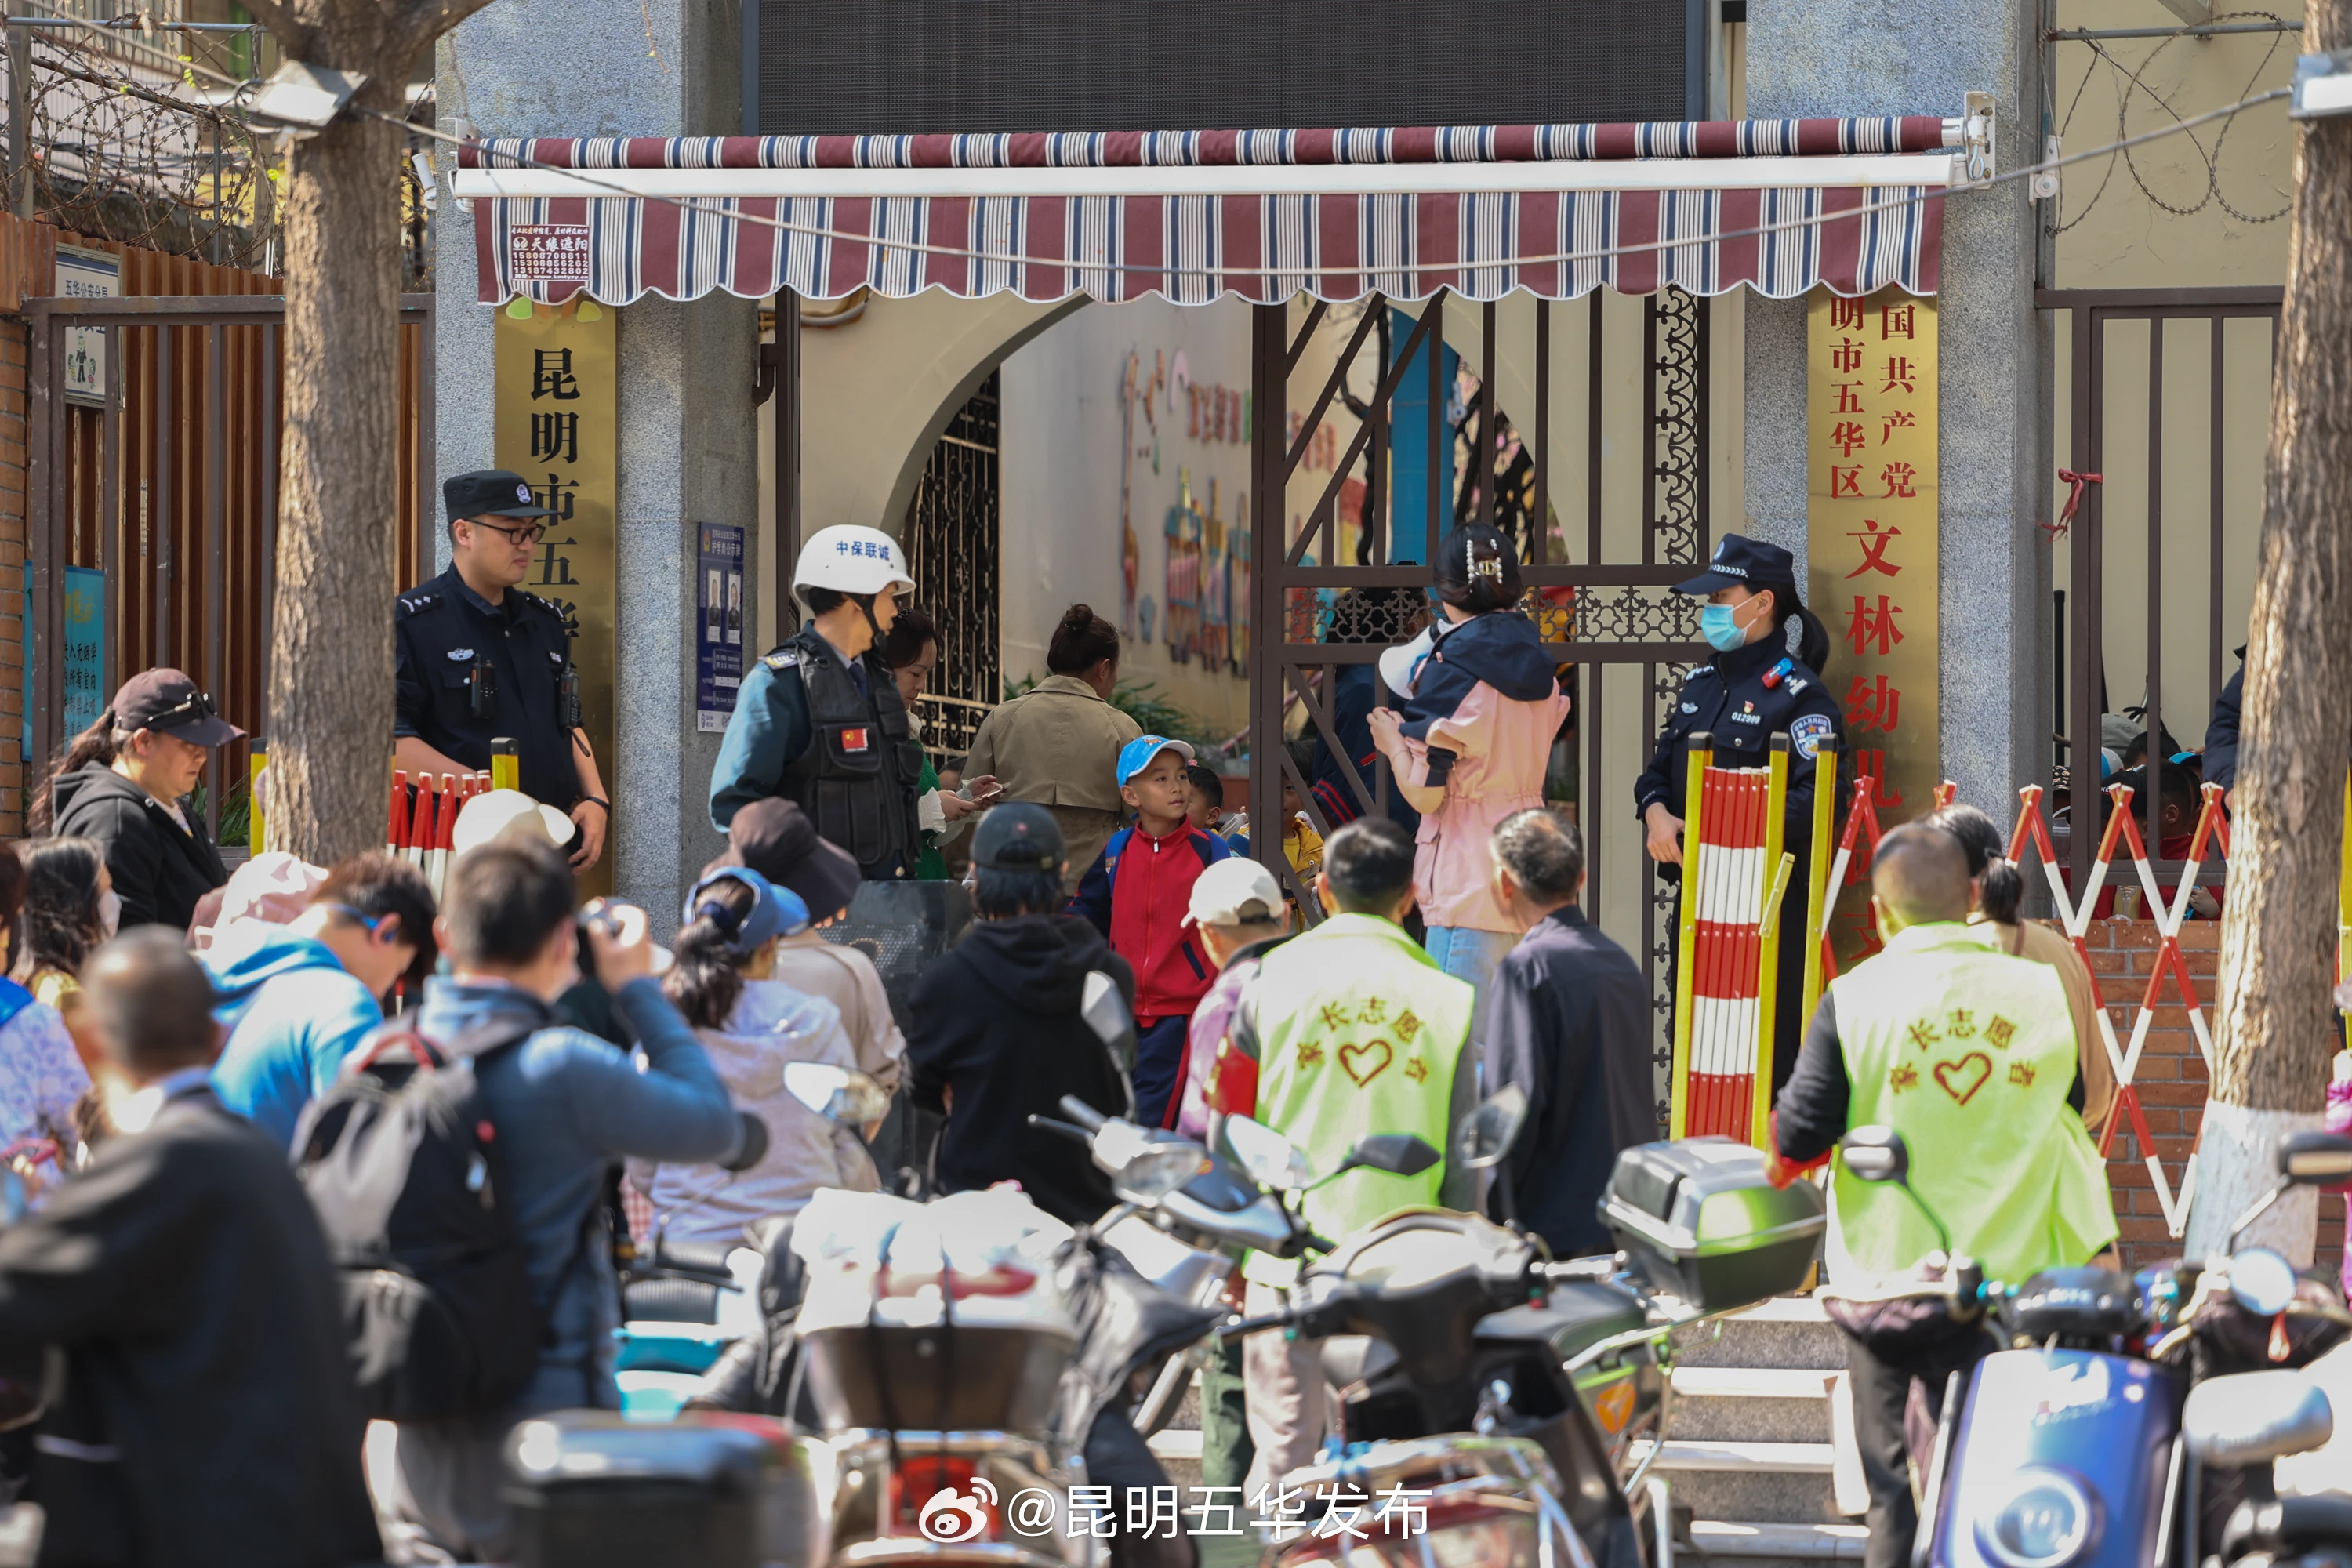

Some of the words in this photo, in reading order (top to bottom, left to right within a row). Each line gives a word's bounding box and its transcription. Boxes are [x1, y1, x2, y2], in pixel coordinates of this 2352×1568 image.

[531, 236, 589, 252] 天缘遮阳
[65, 279, 108, 298] 五华公安分局
[1878, 281, 1917, 499] 国共产党
[836, 540, 891, 562] 中保联诚
